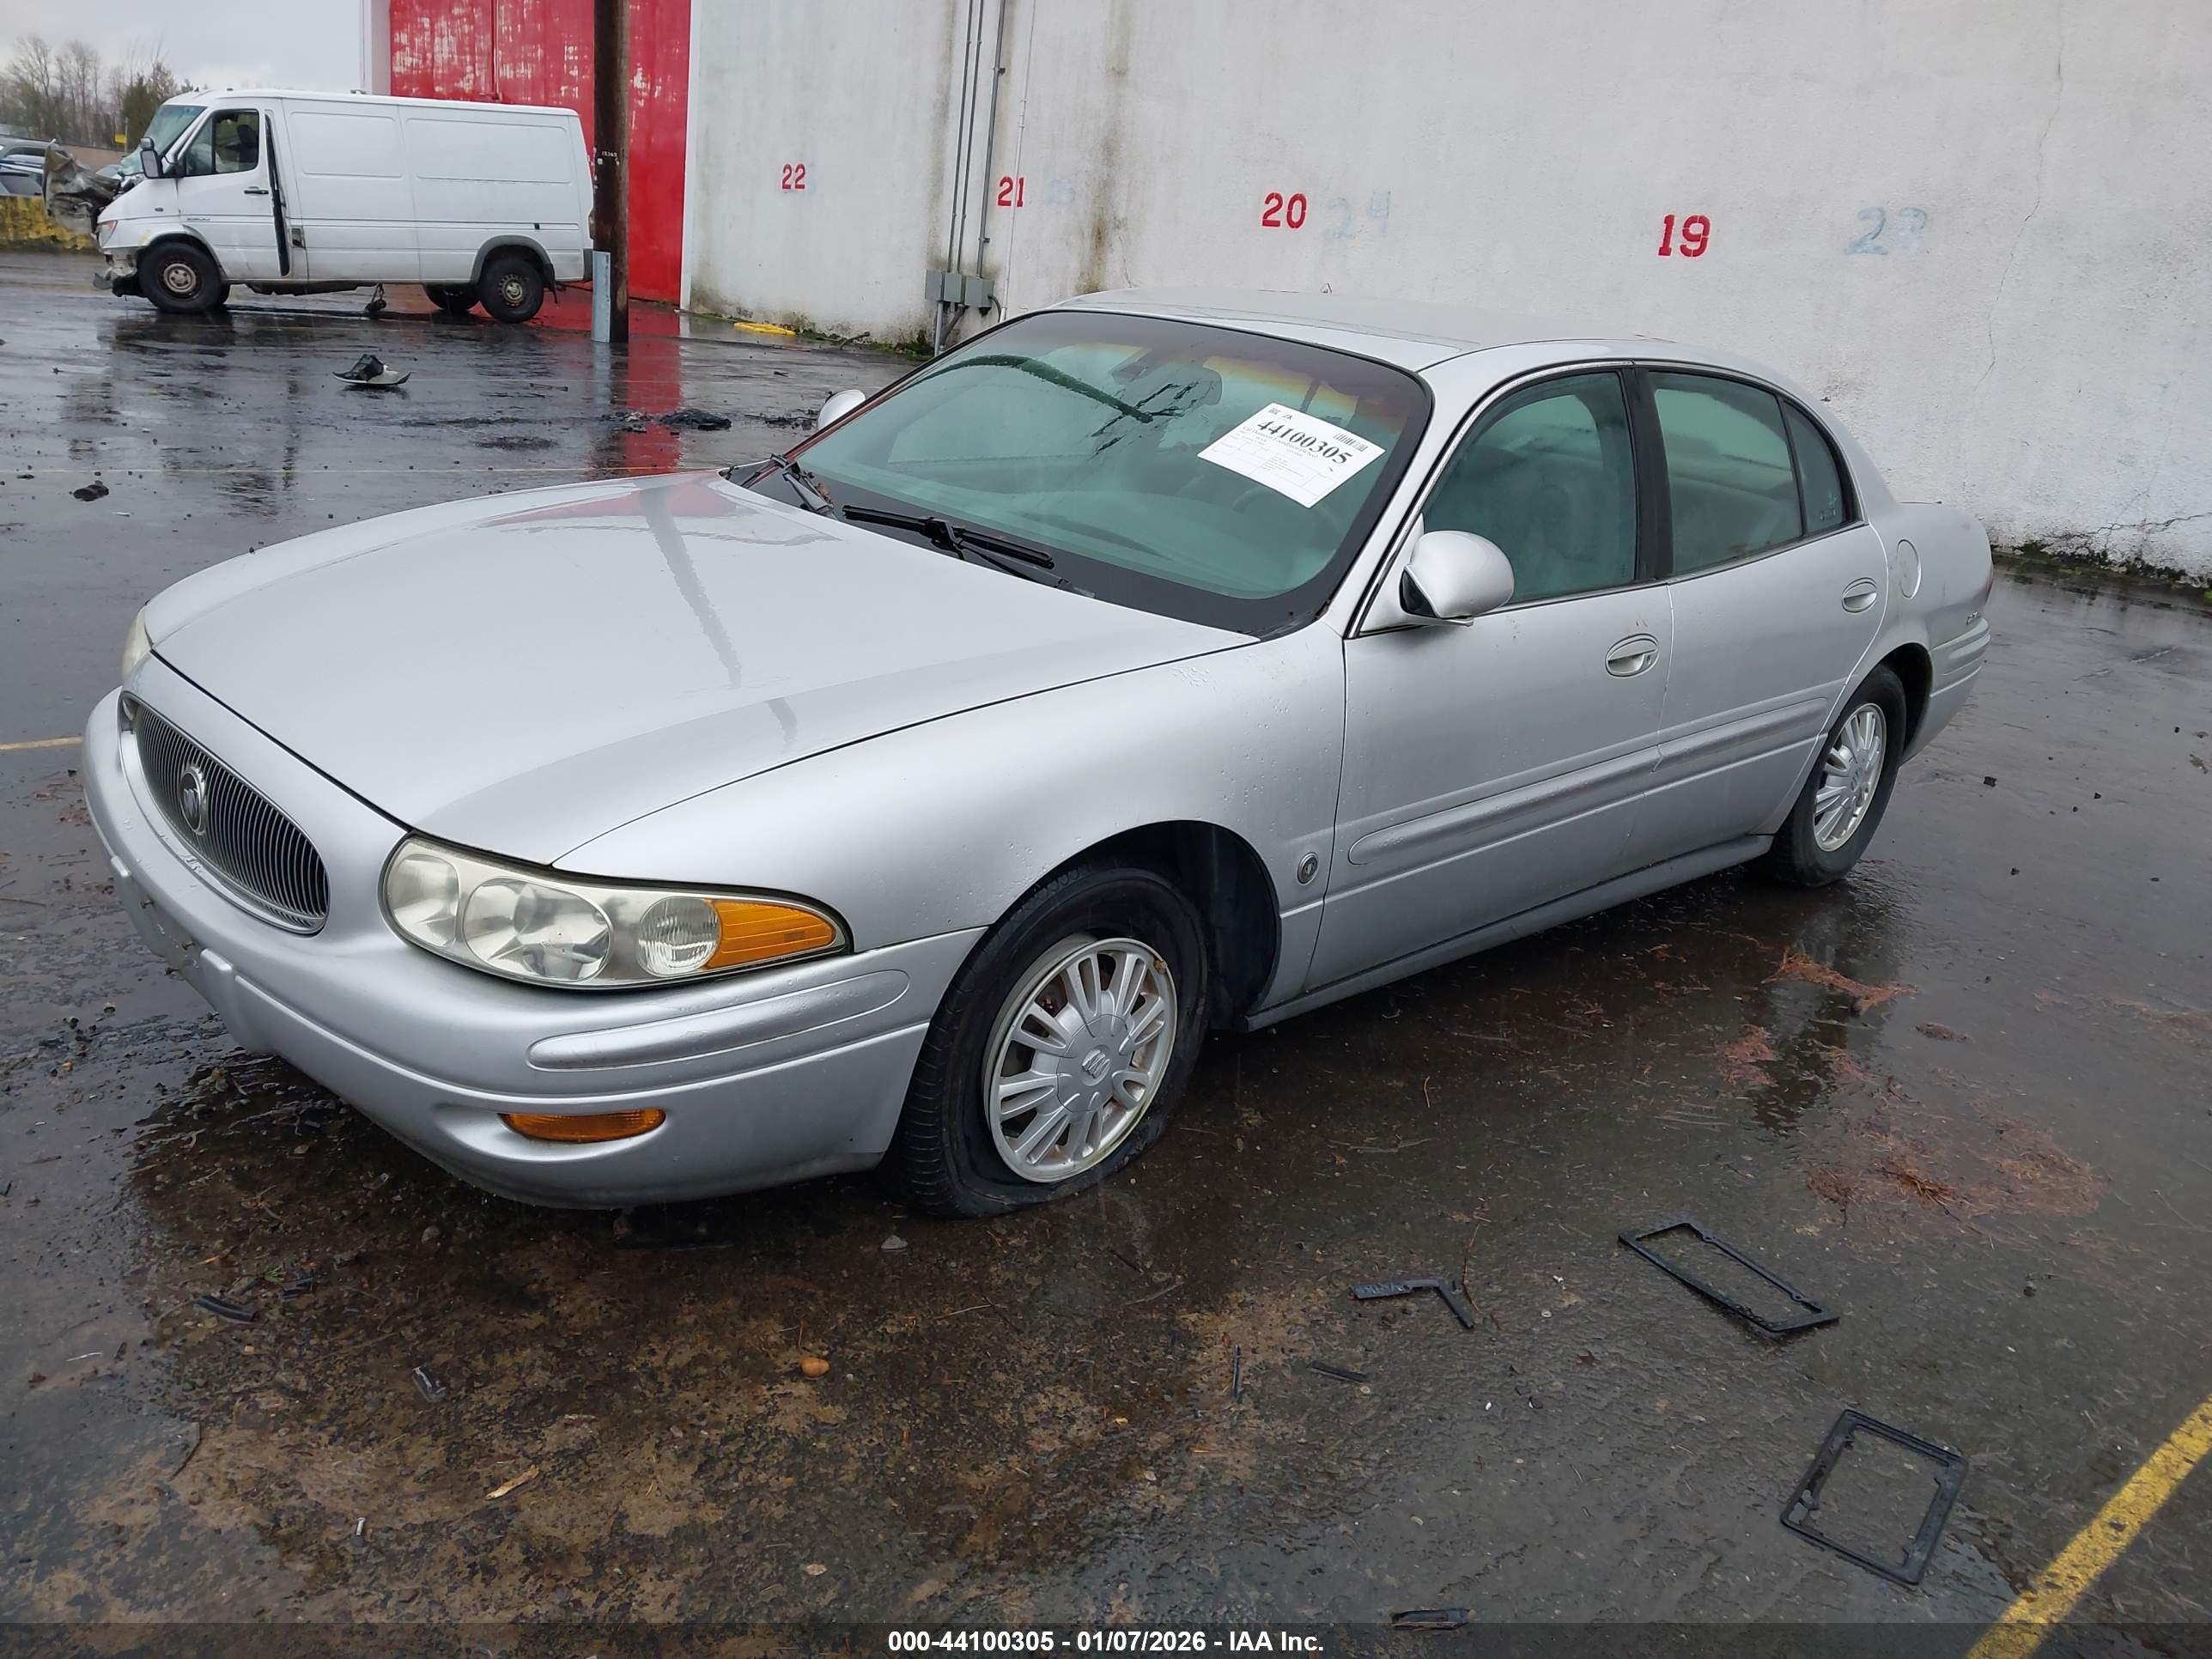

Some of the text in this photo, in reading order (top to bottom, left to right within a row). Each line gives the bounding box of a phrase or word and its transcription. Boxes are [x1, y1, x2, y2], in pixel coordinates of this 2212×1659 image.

[781, 163, 805, 190] 22
[998, 176, 1024, 207] 21
[1261, 192, 1307, 229] 20
[1657, 214, 1711, 258] 19
[1256, 420, 1353, 465] 44100305
